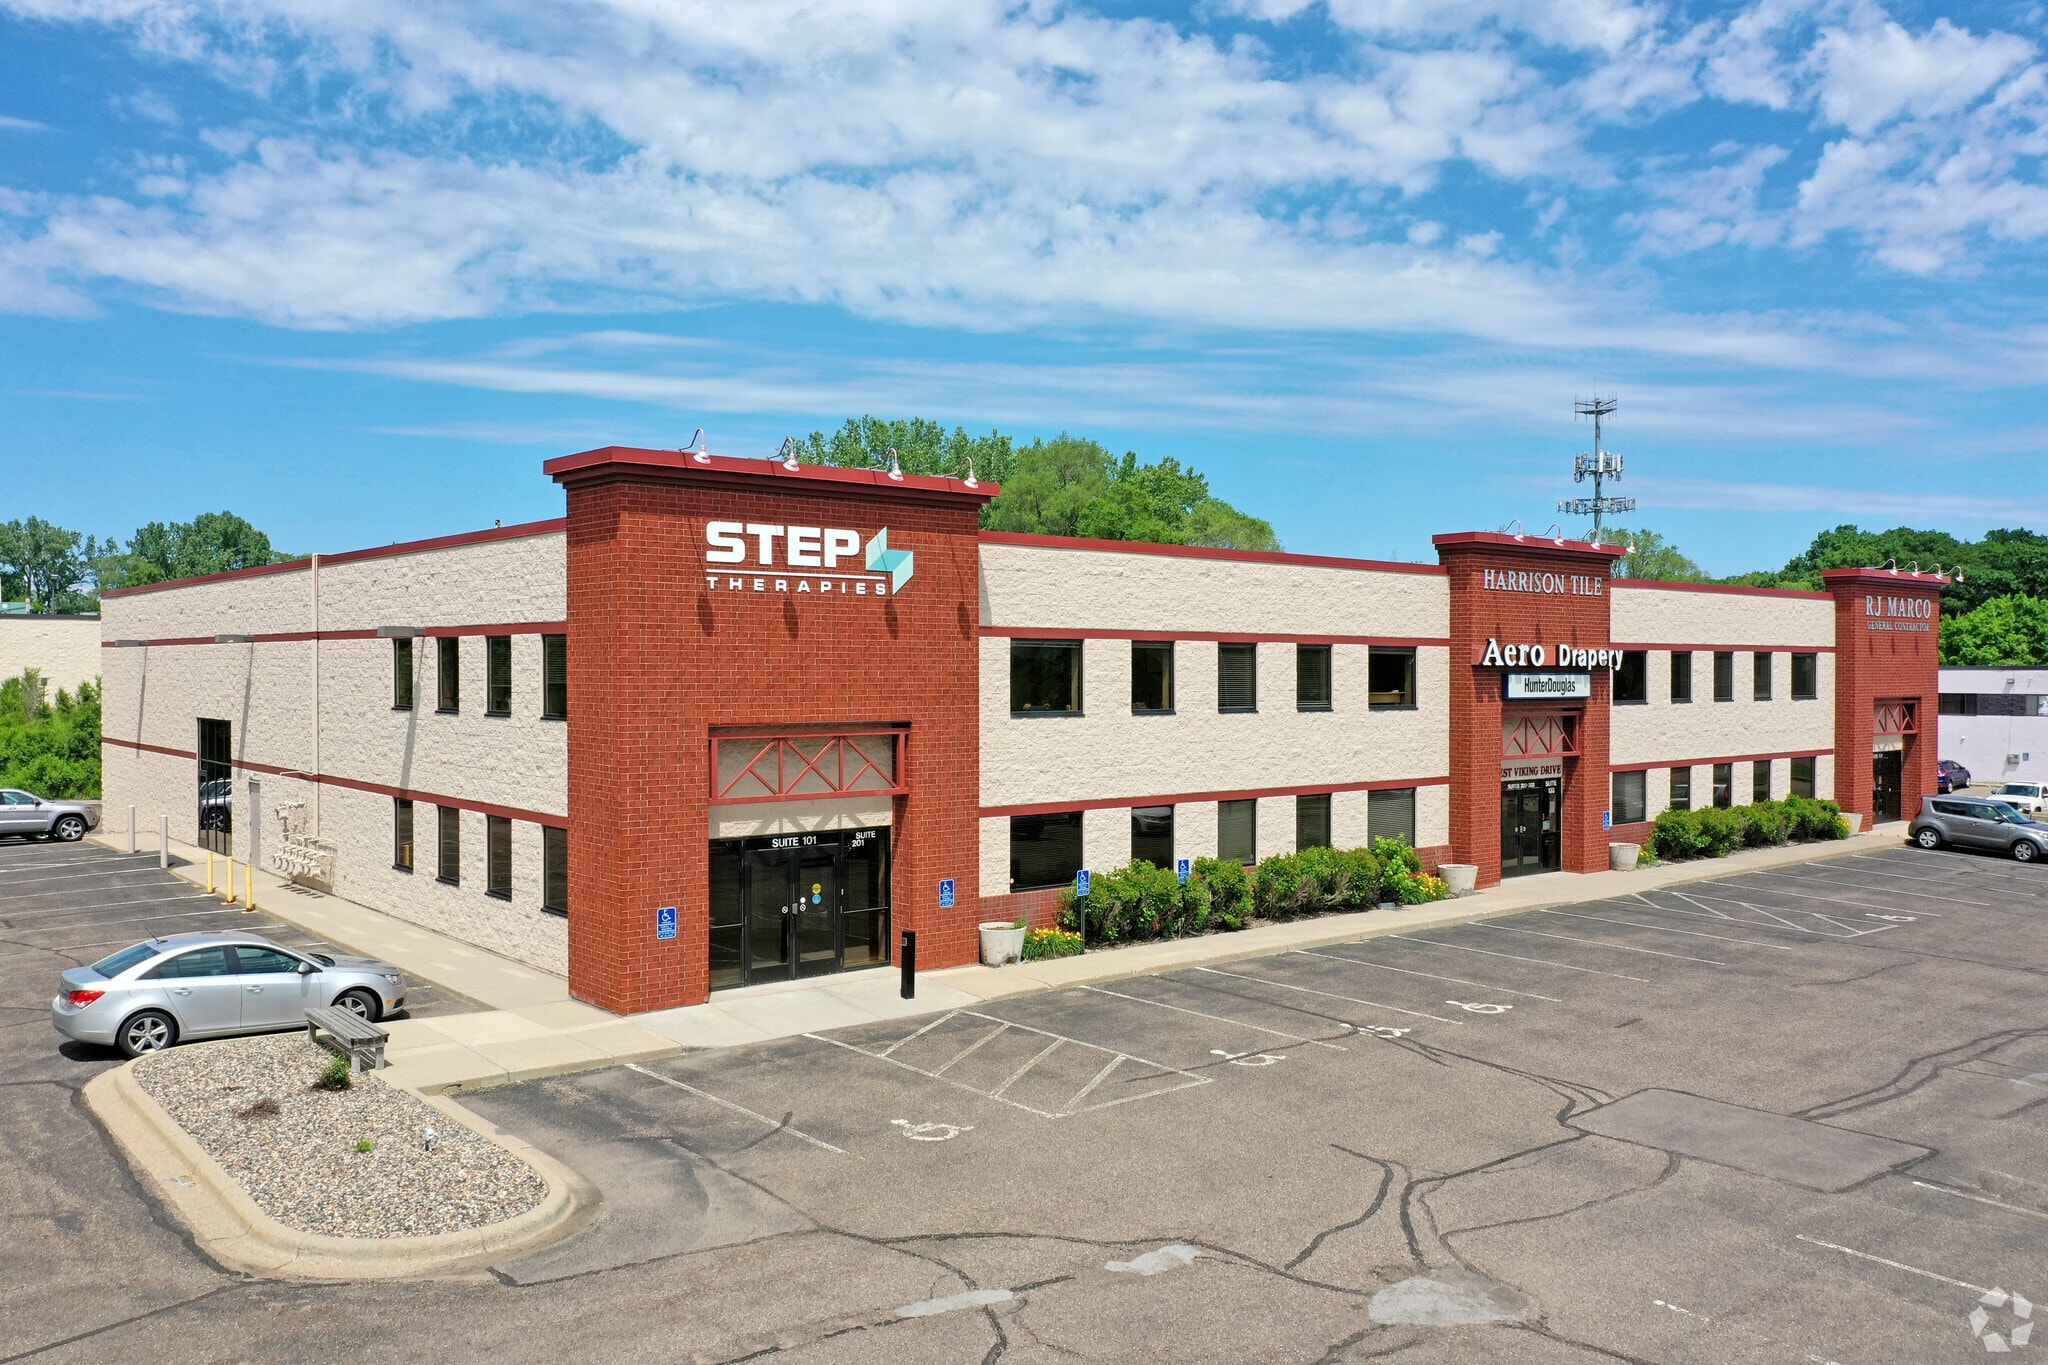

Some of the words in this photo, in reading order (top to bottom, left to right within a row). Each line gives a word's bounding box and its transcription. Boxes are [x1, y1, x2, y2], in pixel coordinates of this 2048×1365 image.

[706, 521, 860, 568] STEP
[706, 577, 886, 596] THERAPIES
[1484, 569, 1565, 594] HARRISON
[1570, 575, 1603, 596] TILE
[1865, 595, 1882, 616] RJ
[1887, 596, 1931, 619] MARCO
[1482, 638, 1546, 667] Aero
[1559, 644, 1624, 671] Drapery
[1524, 677, 1576, 695] HunterDouglas
[1514, 766, 1539, 776] VIKING
[1540, 765, 1561, 775] DRIVE
[771, 837, 800, 848] SUITE
[802, 836, 817, 845] 101
[852, 839, 865, 847] 201
[855, 830, 876, 840] SUITE
